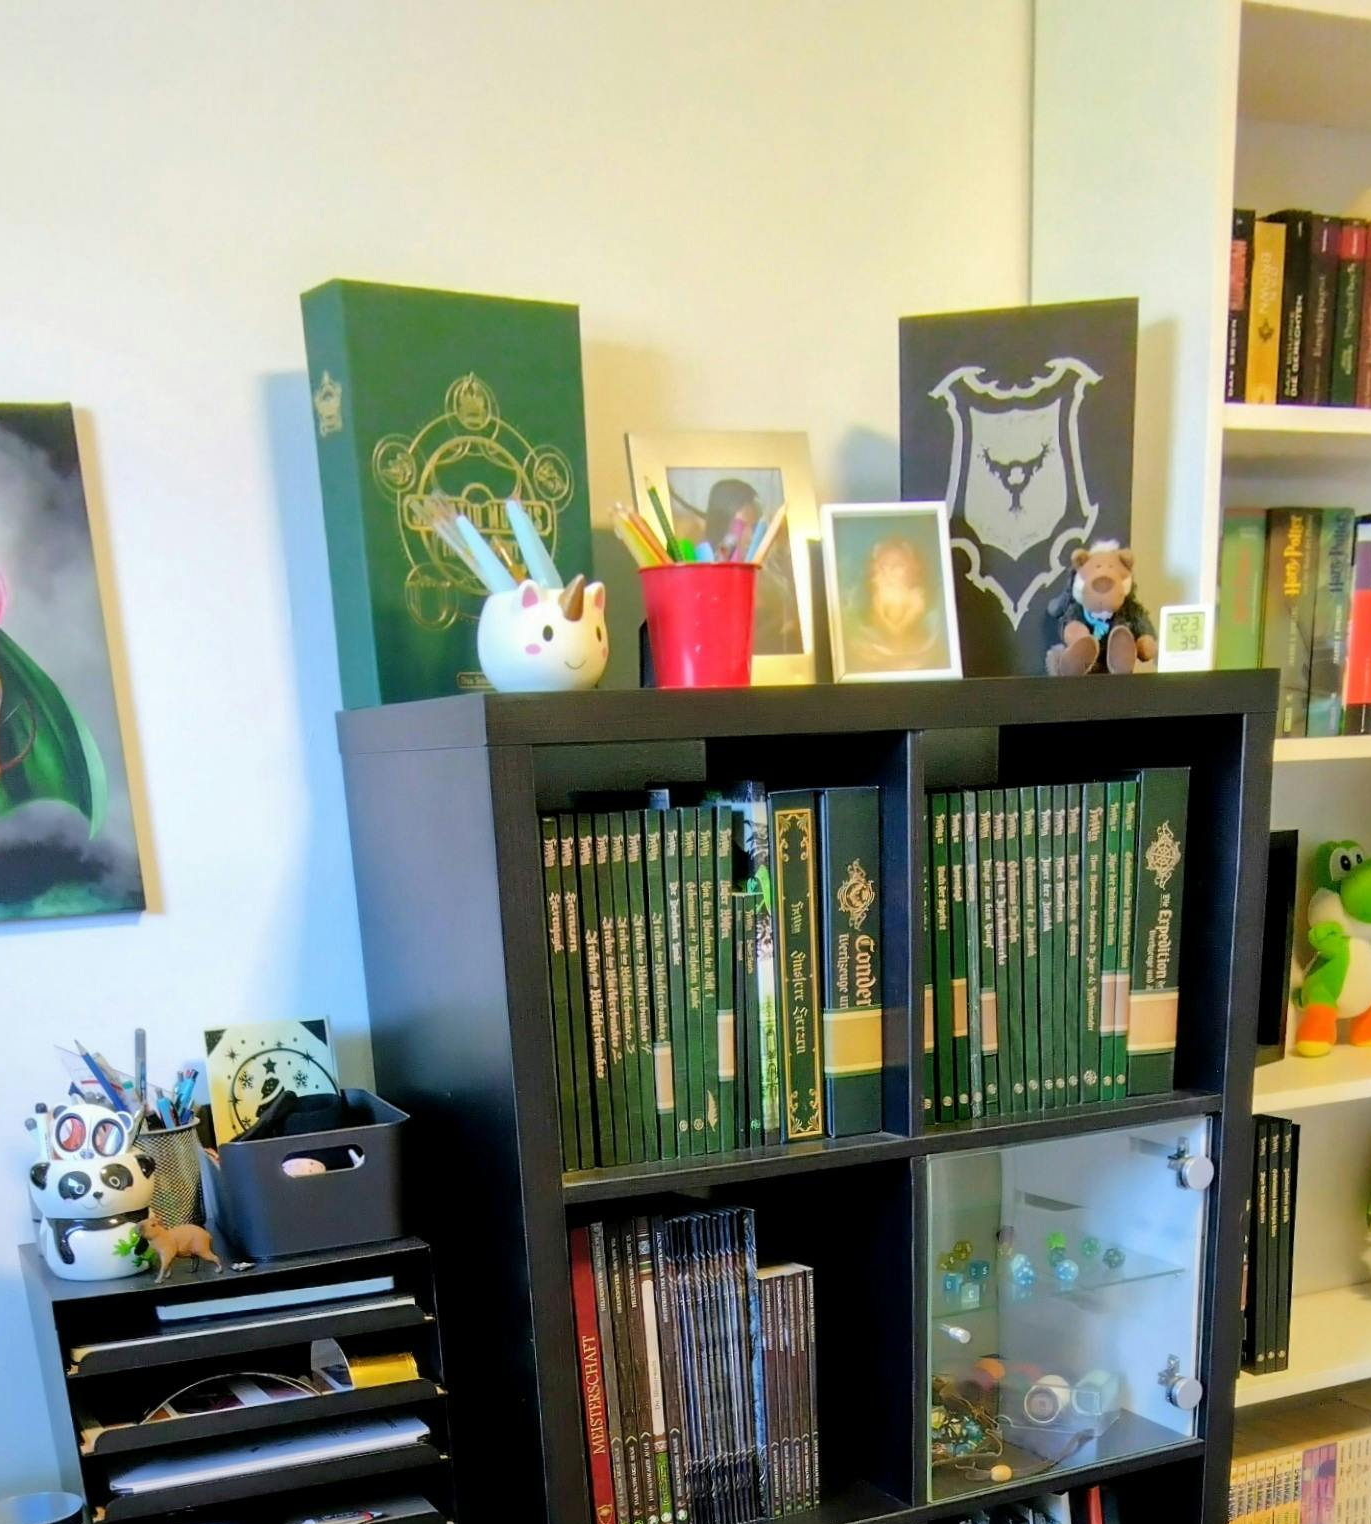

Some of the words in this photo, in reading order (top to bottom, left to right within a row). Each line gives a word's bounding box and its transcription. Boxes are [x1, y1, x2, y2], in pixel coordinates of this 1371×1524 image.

[1284, 514, 1304, 558] Potter
[1284, 557, 1302, 597] Harry
[1155, 910, 1173, 979] Expedition
[583, 1335, 606, 1454] MEISTERSCHAFT
